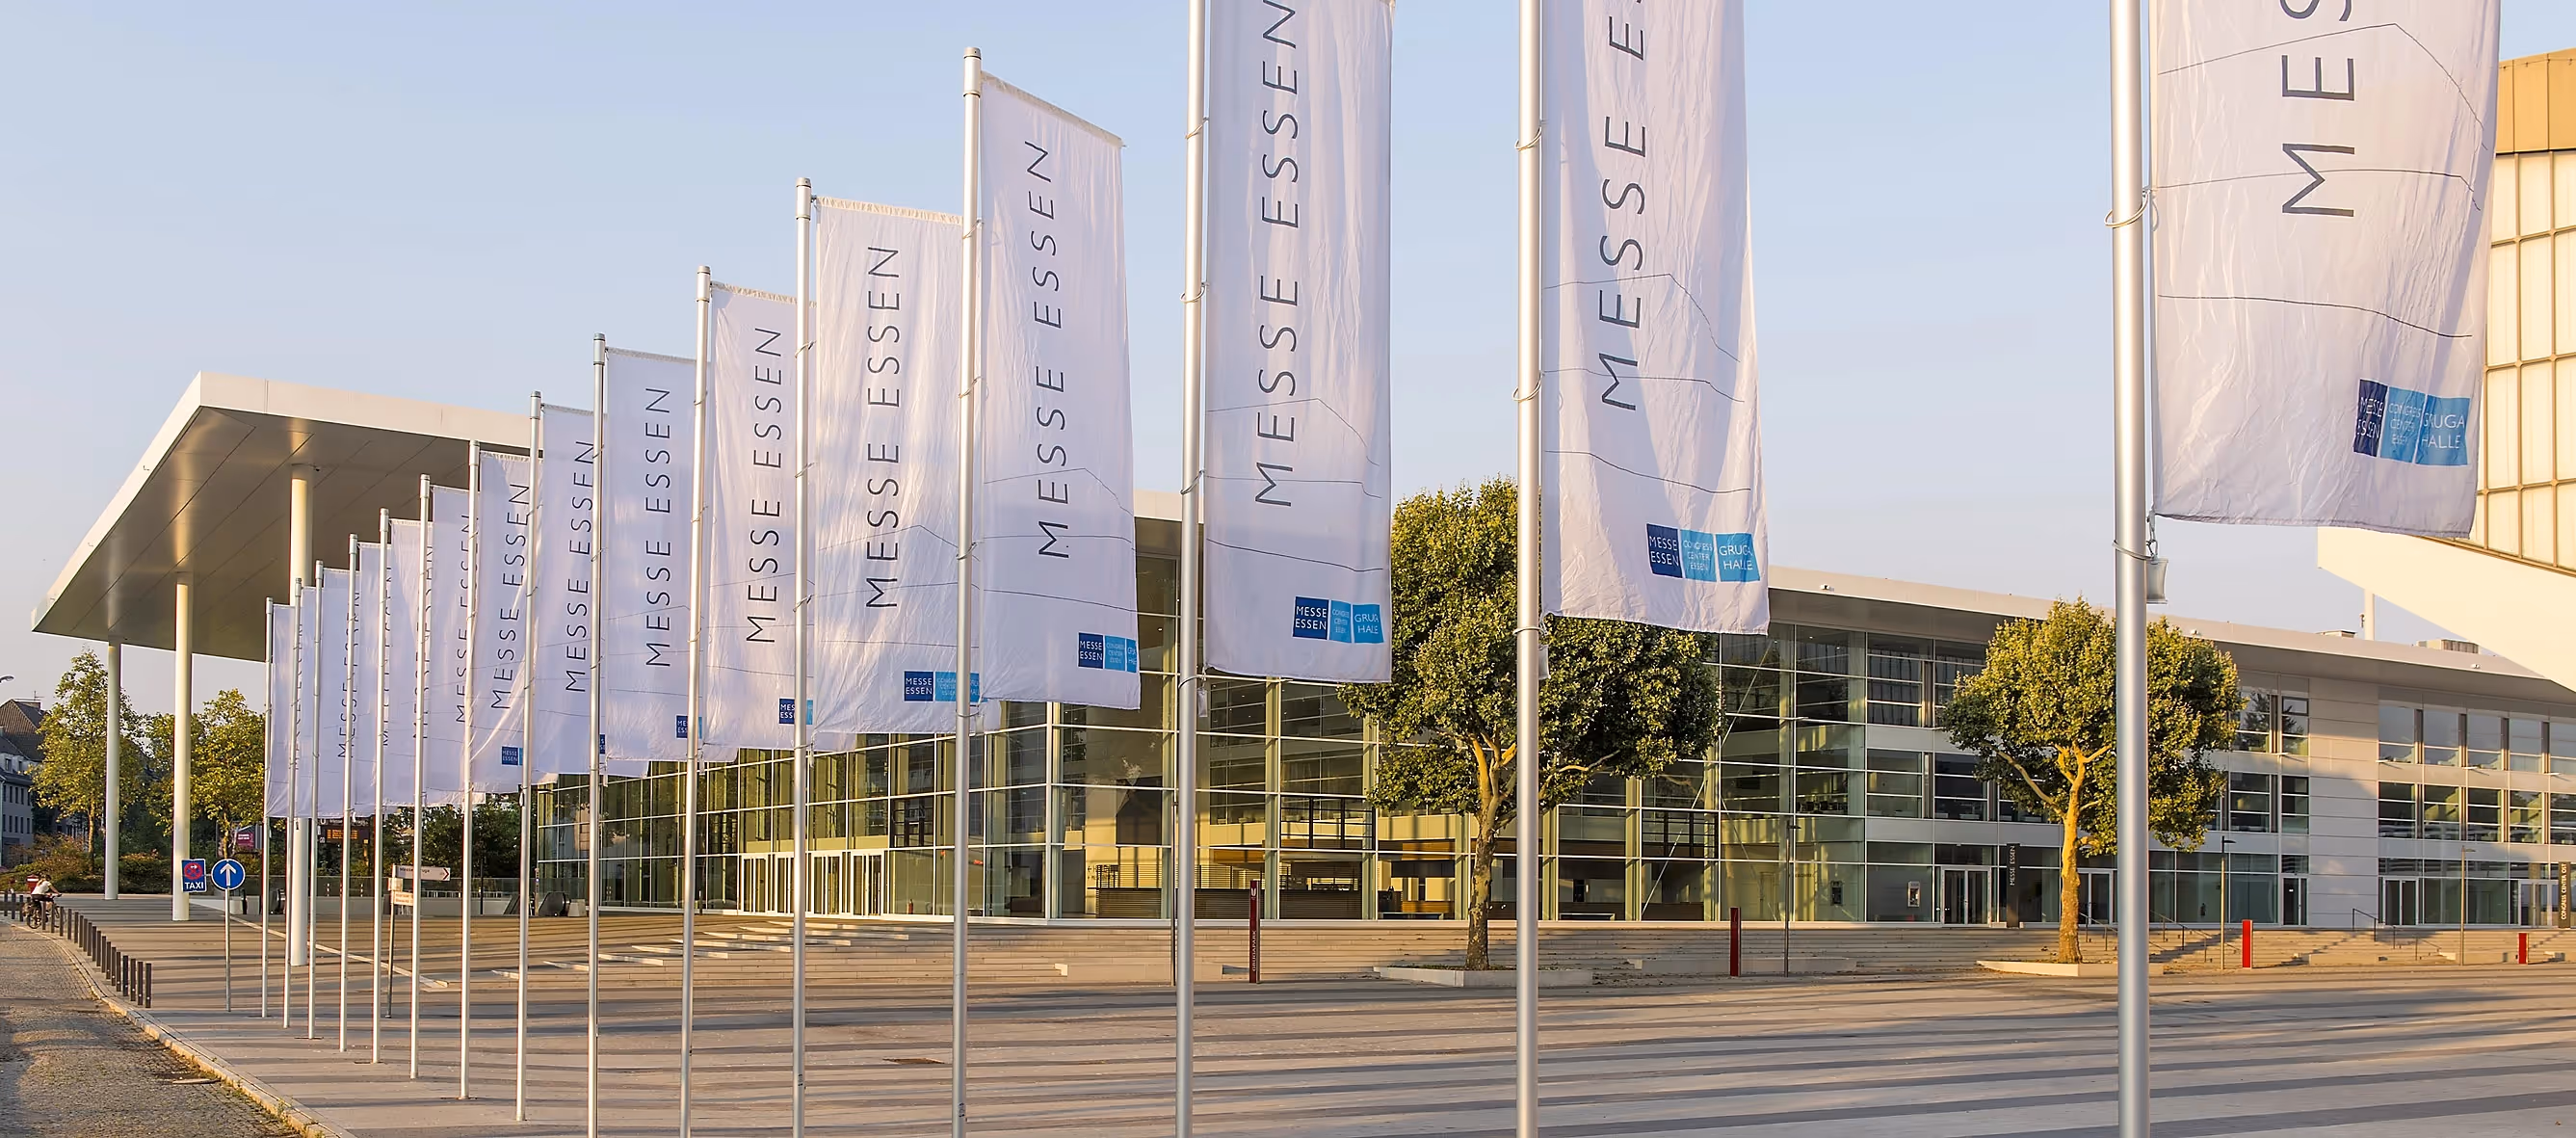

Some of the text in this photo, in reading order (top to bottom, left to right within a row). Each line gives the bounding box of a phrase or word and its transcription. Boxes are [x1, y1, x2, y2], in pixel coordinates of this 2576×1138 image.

[1255, 0, 1299, 507] MESSE ESSEN
[1597, 115, 1645, 410] MESSE
[1025, 141, 1069, 559] MESSE ESSEN
[866, 247, 900, 608] MESSE ESSEN
[746, 328, 782, 643] MESSE ESSEN
[645, 387, 670, 667] MESSE ESSEN
[1649, 536, 1678, 551] MESSE
[565, 441, 593, 692] MESSE ESSEN
[1650, 550, 1679, 567] ESSEN
[491, 484, 530, 709] MESSE ESSEN
[1296, 605, 1327, 618] MESSE
[1354, 613, 1380, 623] GRUA
[1295, 618, 1327, 630] ESSEN
[1079, 640, 1103, 650] MESSE
[1079, 650, 1103, 661] ESSEN
[906, 677, 933, 686] MESSE
[906, 686, 933, 695] ESSEN
[184, 881, 204, 889] TAXI
